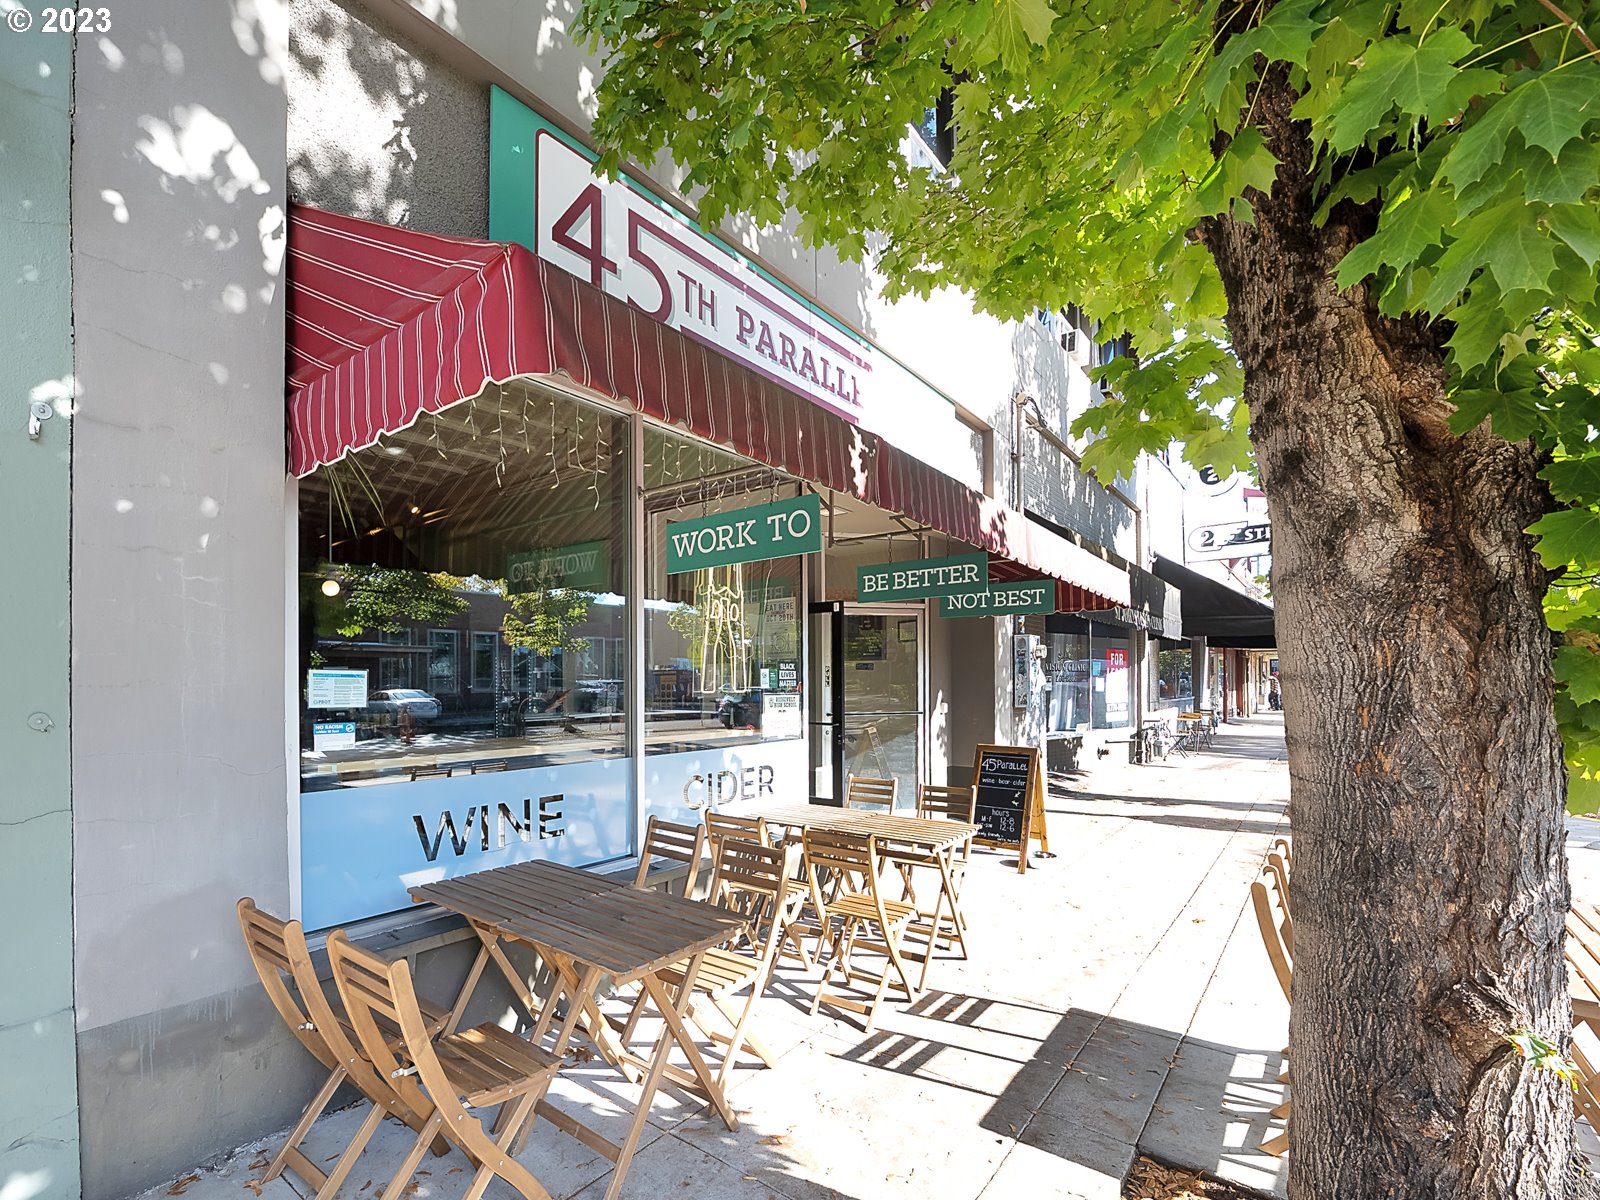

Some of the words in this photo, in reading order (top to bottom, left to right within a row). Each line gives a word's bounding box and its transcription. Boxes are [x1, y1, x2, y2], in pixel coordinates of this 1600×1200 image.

[672, 519, 756, 558] WORK
[767, 510, 811, 541] TO
[1201, 530, 1214, 547] 2
[863, 573, 889, 593] BE
[893, 563, 979, 589] BETTER
[779, 602, 794, 610] HERE
[947, 592, 990, 609] NOT
[993, 589, 1045, 608] BEST
[780, 662, 796, 670] BLACK
[1110, 653, 1124, 666] FOR
[683, 765, 774, 811] CIDER
[991, 809, 1010, 818] hours
[413, 794, 564, 862] WINE
